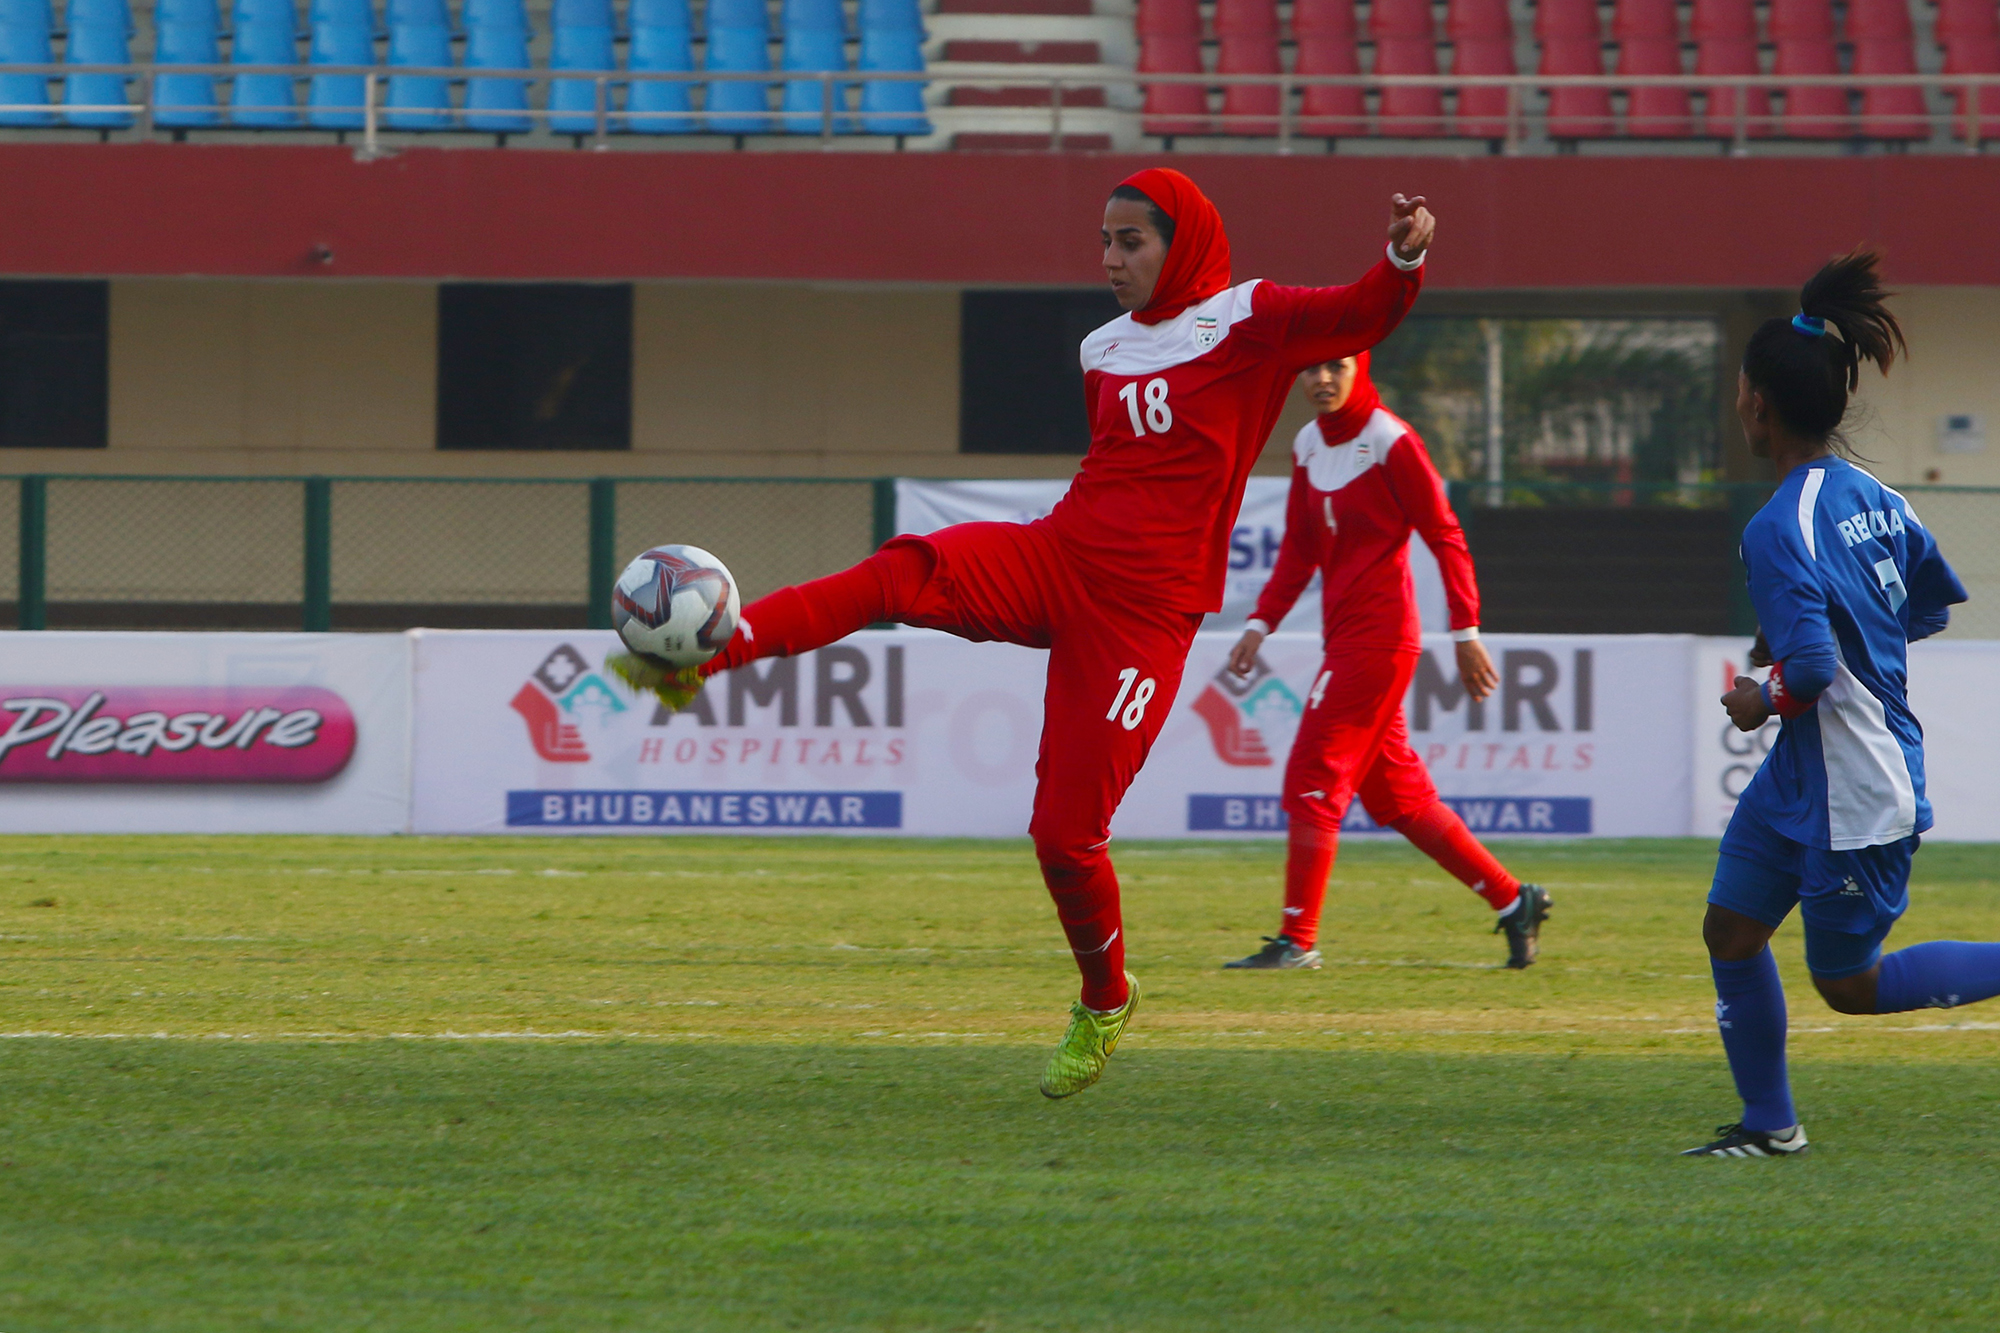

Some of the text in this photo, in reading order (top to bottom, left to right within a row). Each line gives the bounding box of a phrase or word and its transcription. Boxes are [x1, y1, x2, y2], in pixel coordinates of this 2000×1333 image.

[1118, 377, 1172, 438] 18
[1873, 557, 1908, 617] 7
[1105, 666, 1156, 731] 18
[1310, 670, 1333, 709] 4
[1411, 648, 1595, 732] MRI
[0, 691, 323, 762] Pleasure
[638, 738, 906, 765] HOSPITALS
[1428, 743, 1596, 771] PITALS
[541, 795, 865, 823] BHUBANESWAR
